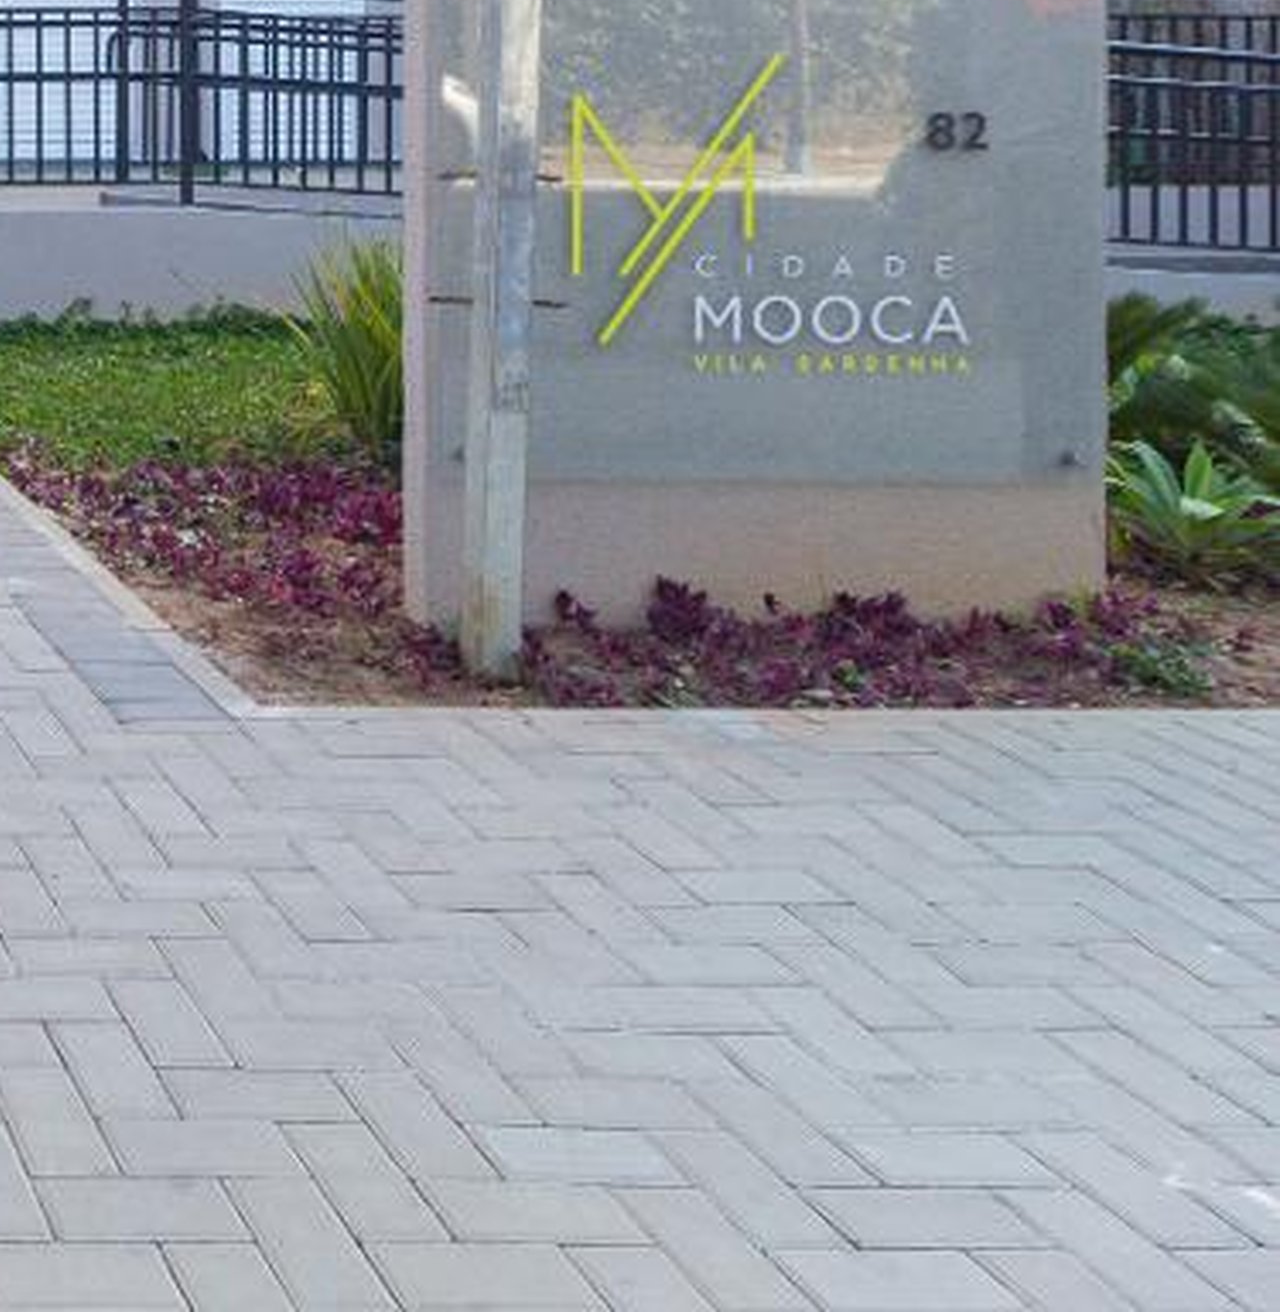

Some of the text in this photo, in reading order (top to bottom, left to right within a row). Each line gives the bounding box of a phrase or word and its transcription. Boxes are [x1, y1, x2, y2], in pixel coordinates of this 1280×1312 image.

[925, 112, 988, 151] 82
[694, 254, 956, 278] CIDADE
[693, 294, 971, 343] MOOCA
[693, 353, 766, 374] VILA
